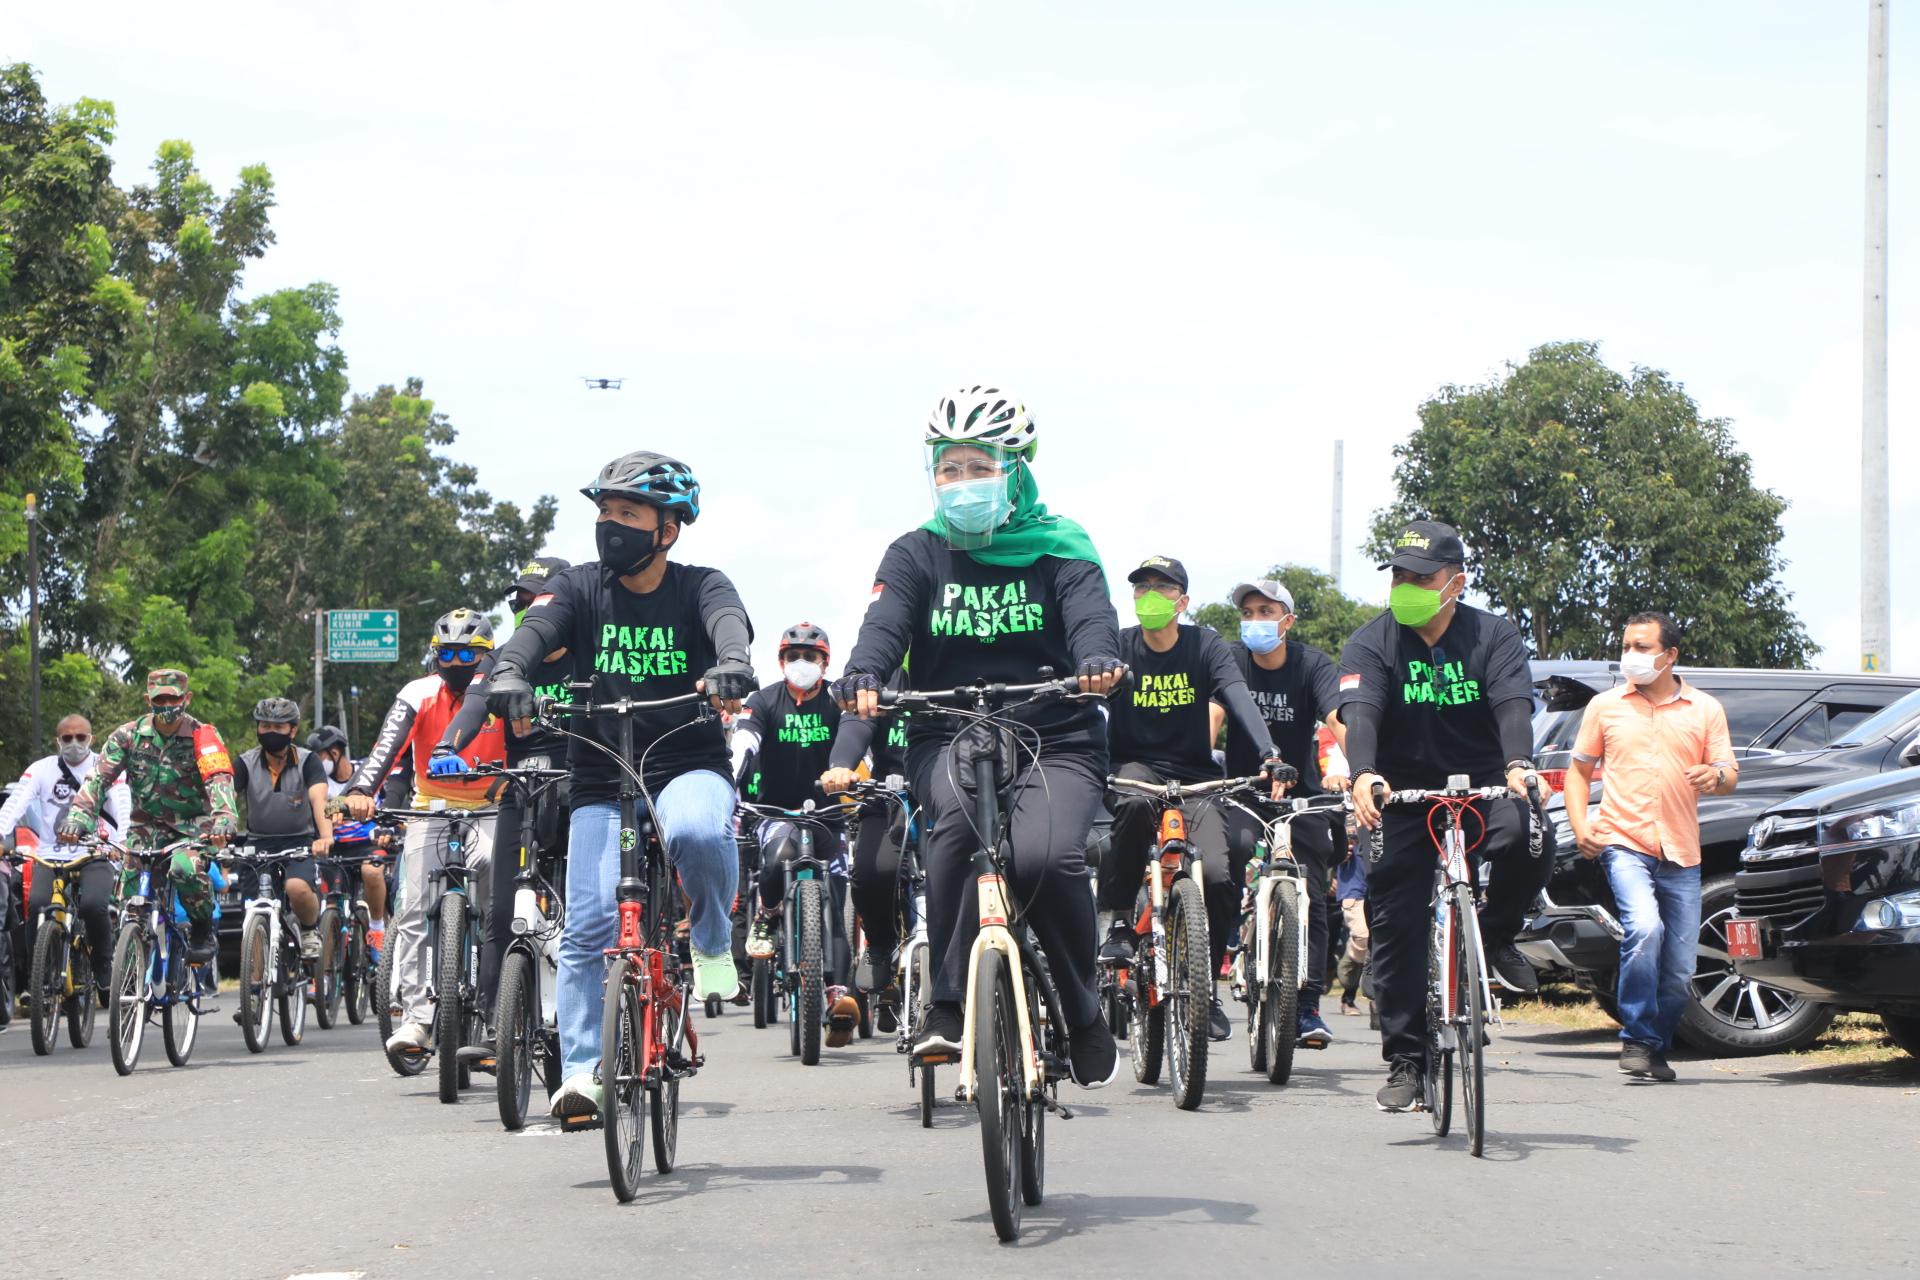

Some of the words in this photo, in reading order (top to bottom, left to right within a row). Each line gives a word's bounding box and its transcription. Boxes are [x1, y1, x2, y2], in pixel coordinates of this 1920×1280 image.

[332, 612, 370, 621] JEMBER
[931, 603, 1043, 637] MASKER
[332, 620, 362, 628] KUNIR
[332, 631, 358, 640] KOTA
[332, 639, 379, 648] LUMAJANG
[595, 649, 688, 676] MASKER
[630, 675, 645, 683] KIP
[1133, 687, 1195, 707] MASKER
[778, 726, 831, 743] MASKER
